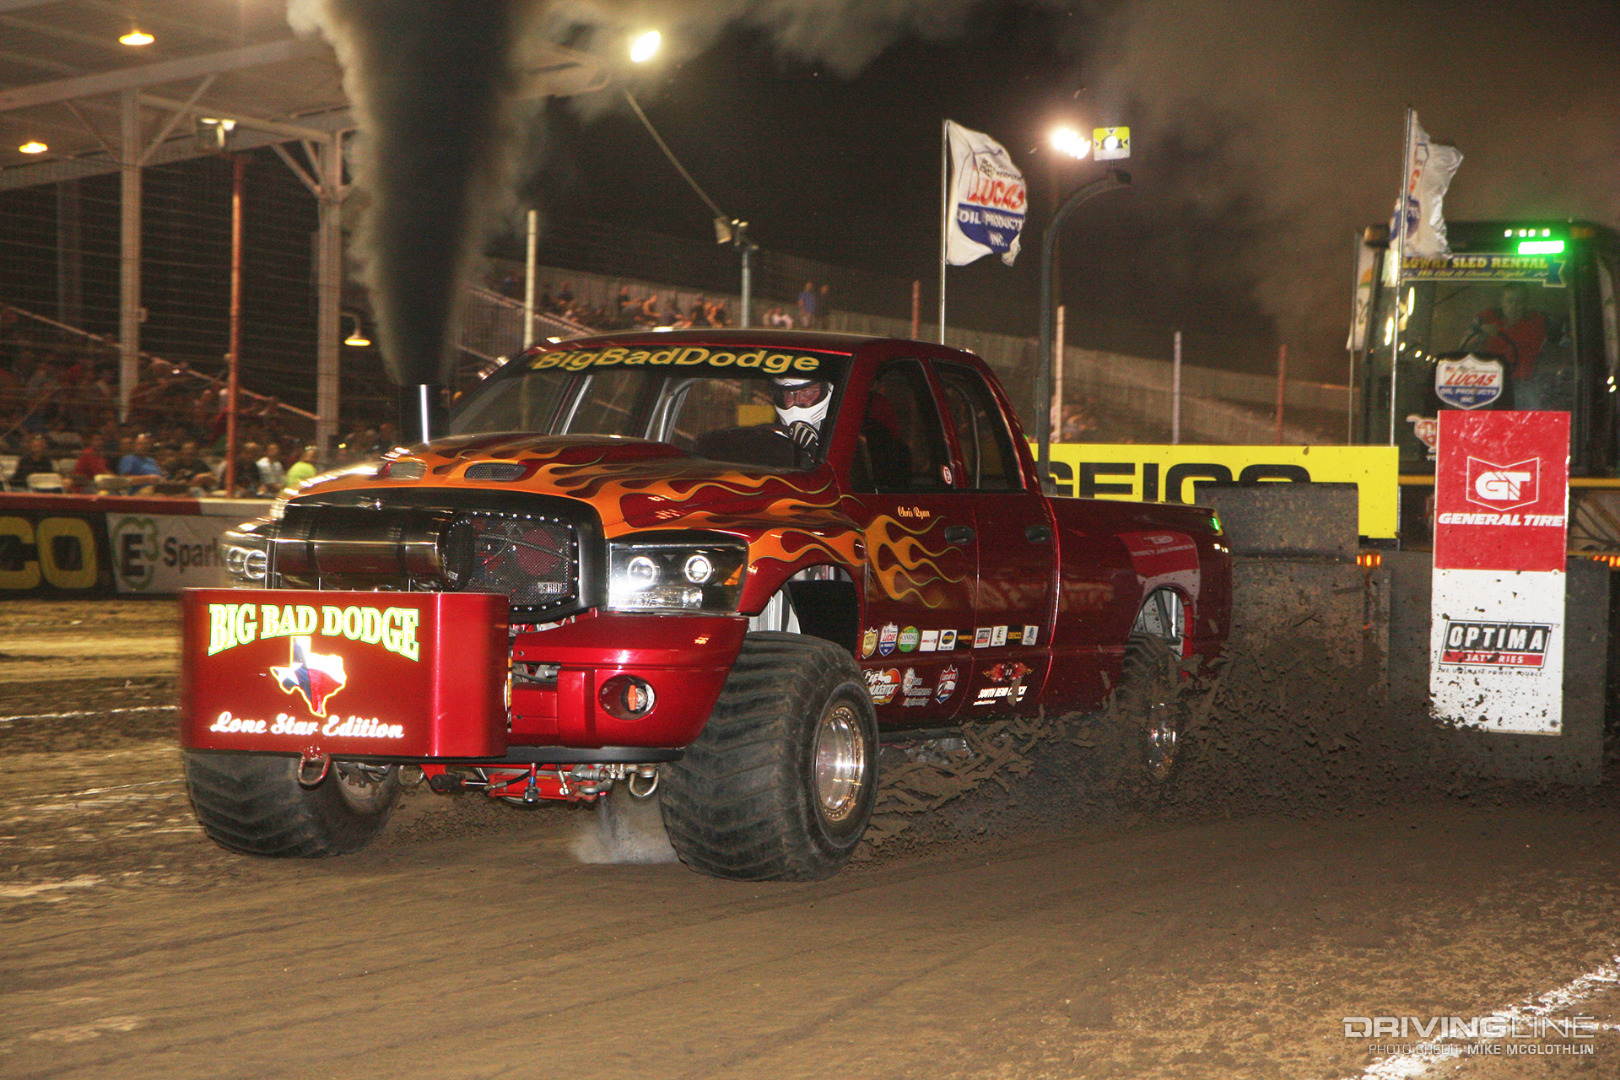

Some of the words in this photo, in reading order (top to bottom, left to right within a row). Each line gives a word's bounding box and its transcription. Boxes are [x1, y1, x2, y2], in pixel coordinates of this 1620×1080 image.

[968, 179, 1024, 210] LUCAS
[960, 210, 982, 224] OIL
[1452, 257, 1487, 269] SLED
[1491, 257, 1549, 269] RENTAL
[531, 347, 820, 374] BigBadDodge
[1445, 373, 1497, 386] LUCAS
[1455, 388, 1497, 396] PROUCTS
[1475, 471, 1531, 501] GT
[1438, 512, 1521, 526] GENERAL
[1523, 514, 1565, 527] TIRE
[207, 603, 258, 657] BIG
[260, 604, 318, 640] BAD
[321, 605, 420, 662] DODGE
[1448, 626, 1544, 650] OPTIMA
[1465, 653, 1524, 664] BATTRIES
[210, 711, 267, 734] Lone
[270, 712, 319, 736] Star
[321, 714, 405, 739] Edition
